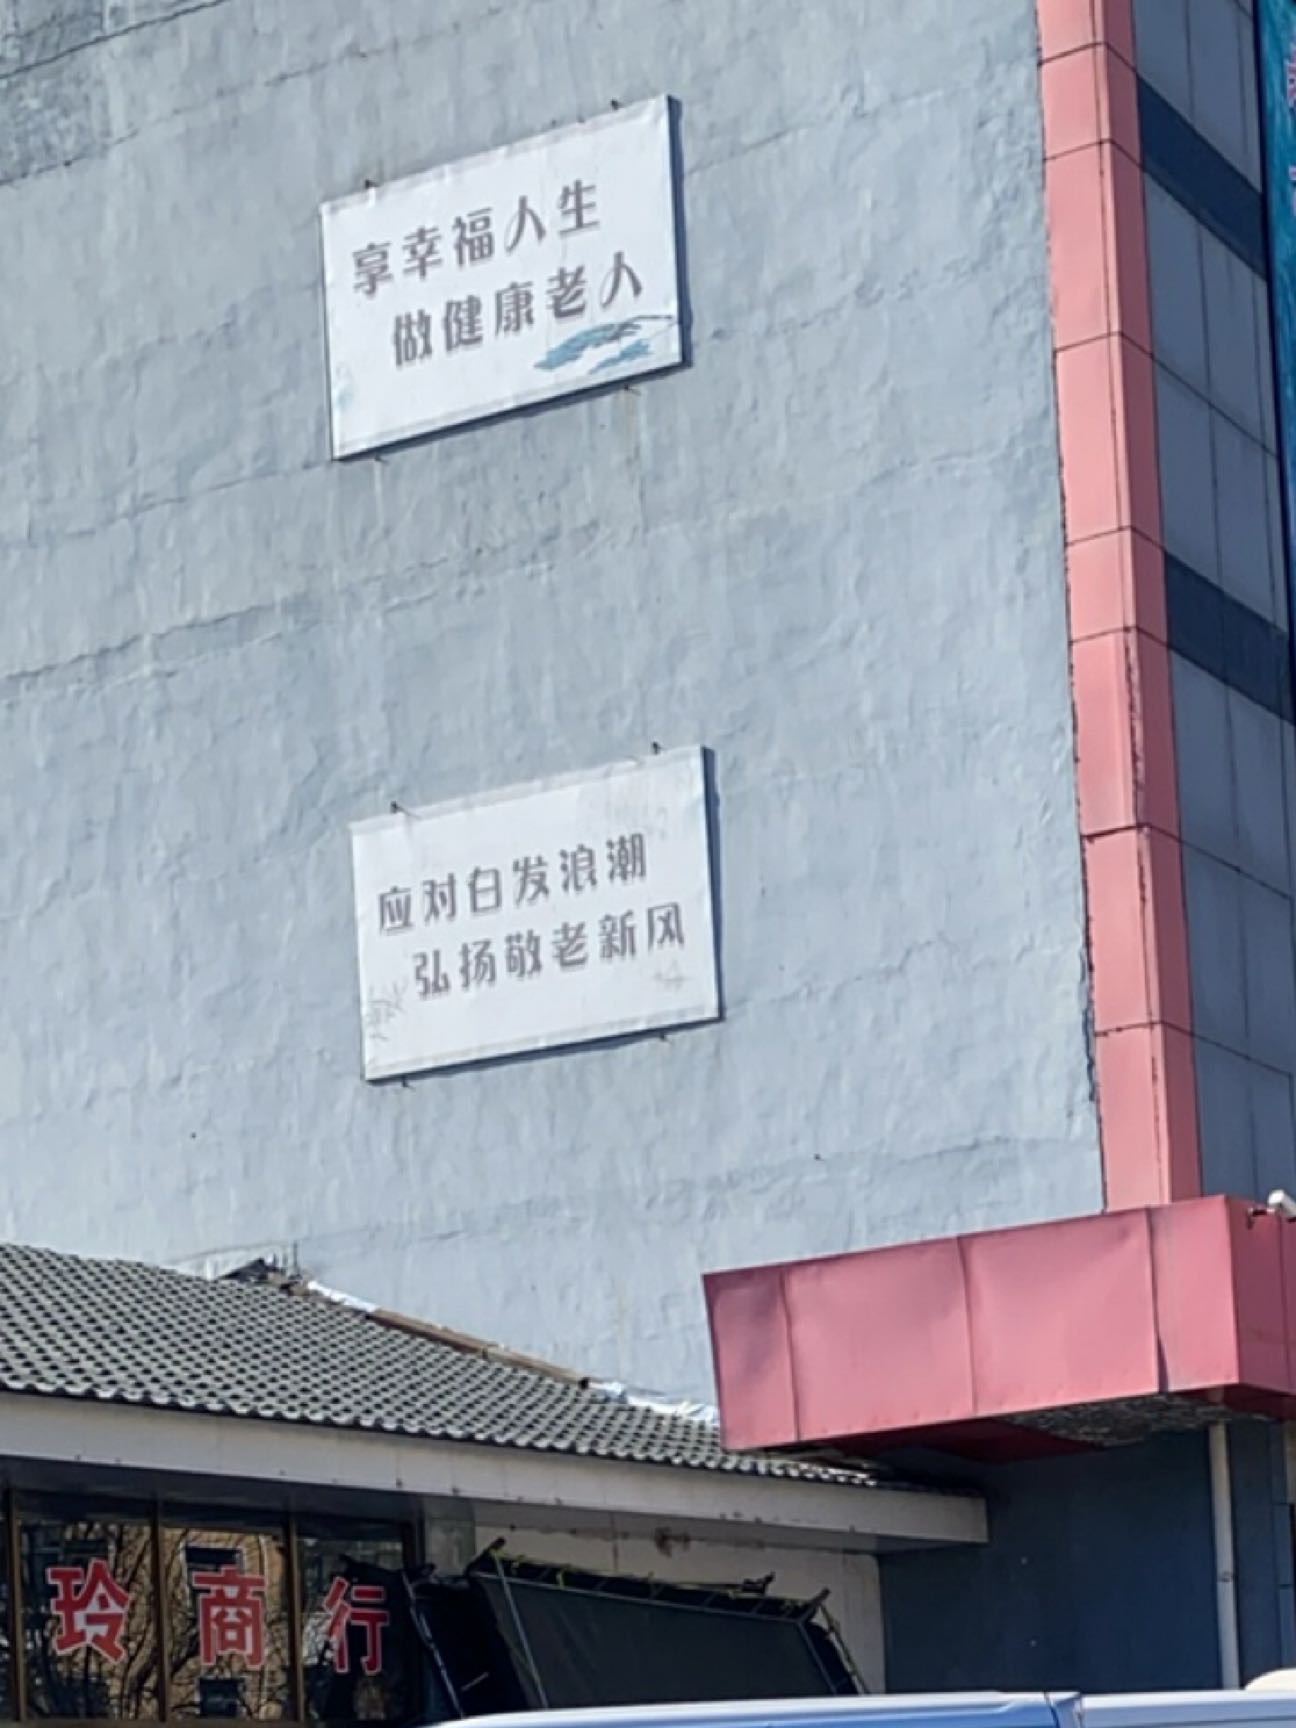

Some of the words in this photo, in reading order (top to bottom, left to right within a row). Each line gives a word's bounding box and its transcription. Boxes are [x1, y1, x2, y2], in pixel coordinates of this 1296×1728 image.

[352, 178, 600, 299] 享幸福人生
[391, 250, 643, 368] 做健康老人
[378, 832, 648, 934] 应对白发浪潮
[413, 901, 686, 998] 弘扬敬老新风
